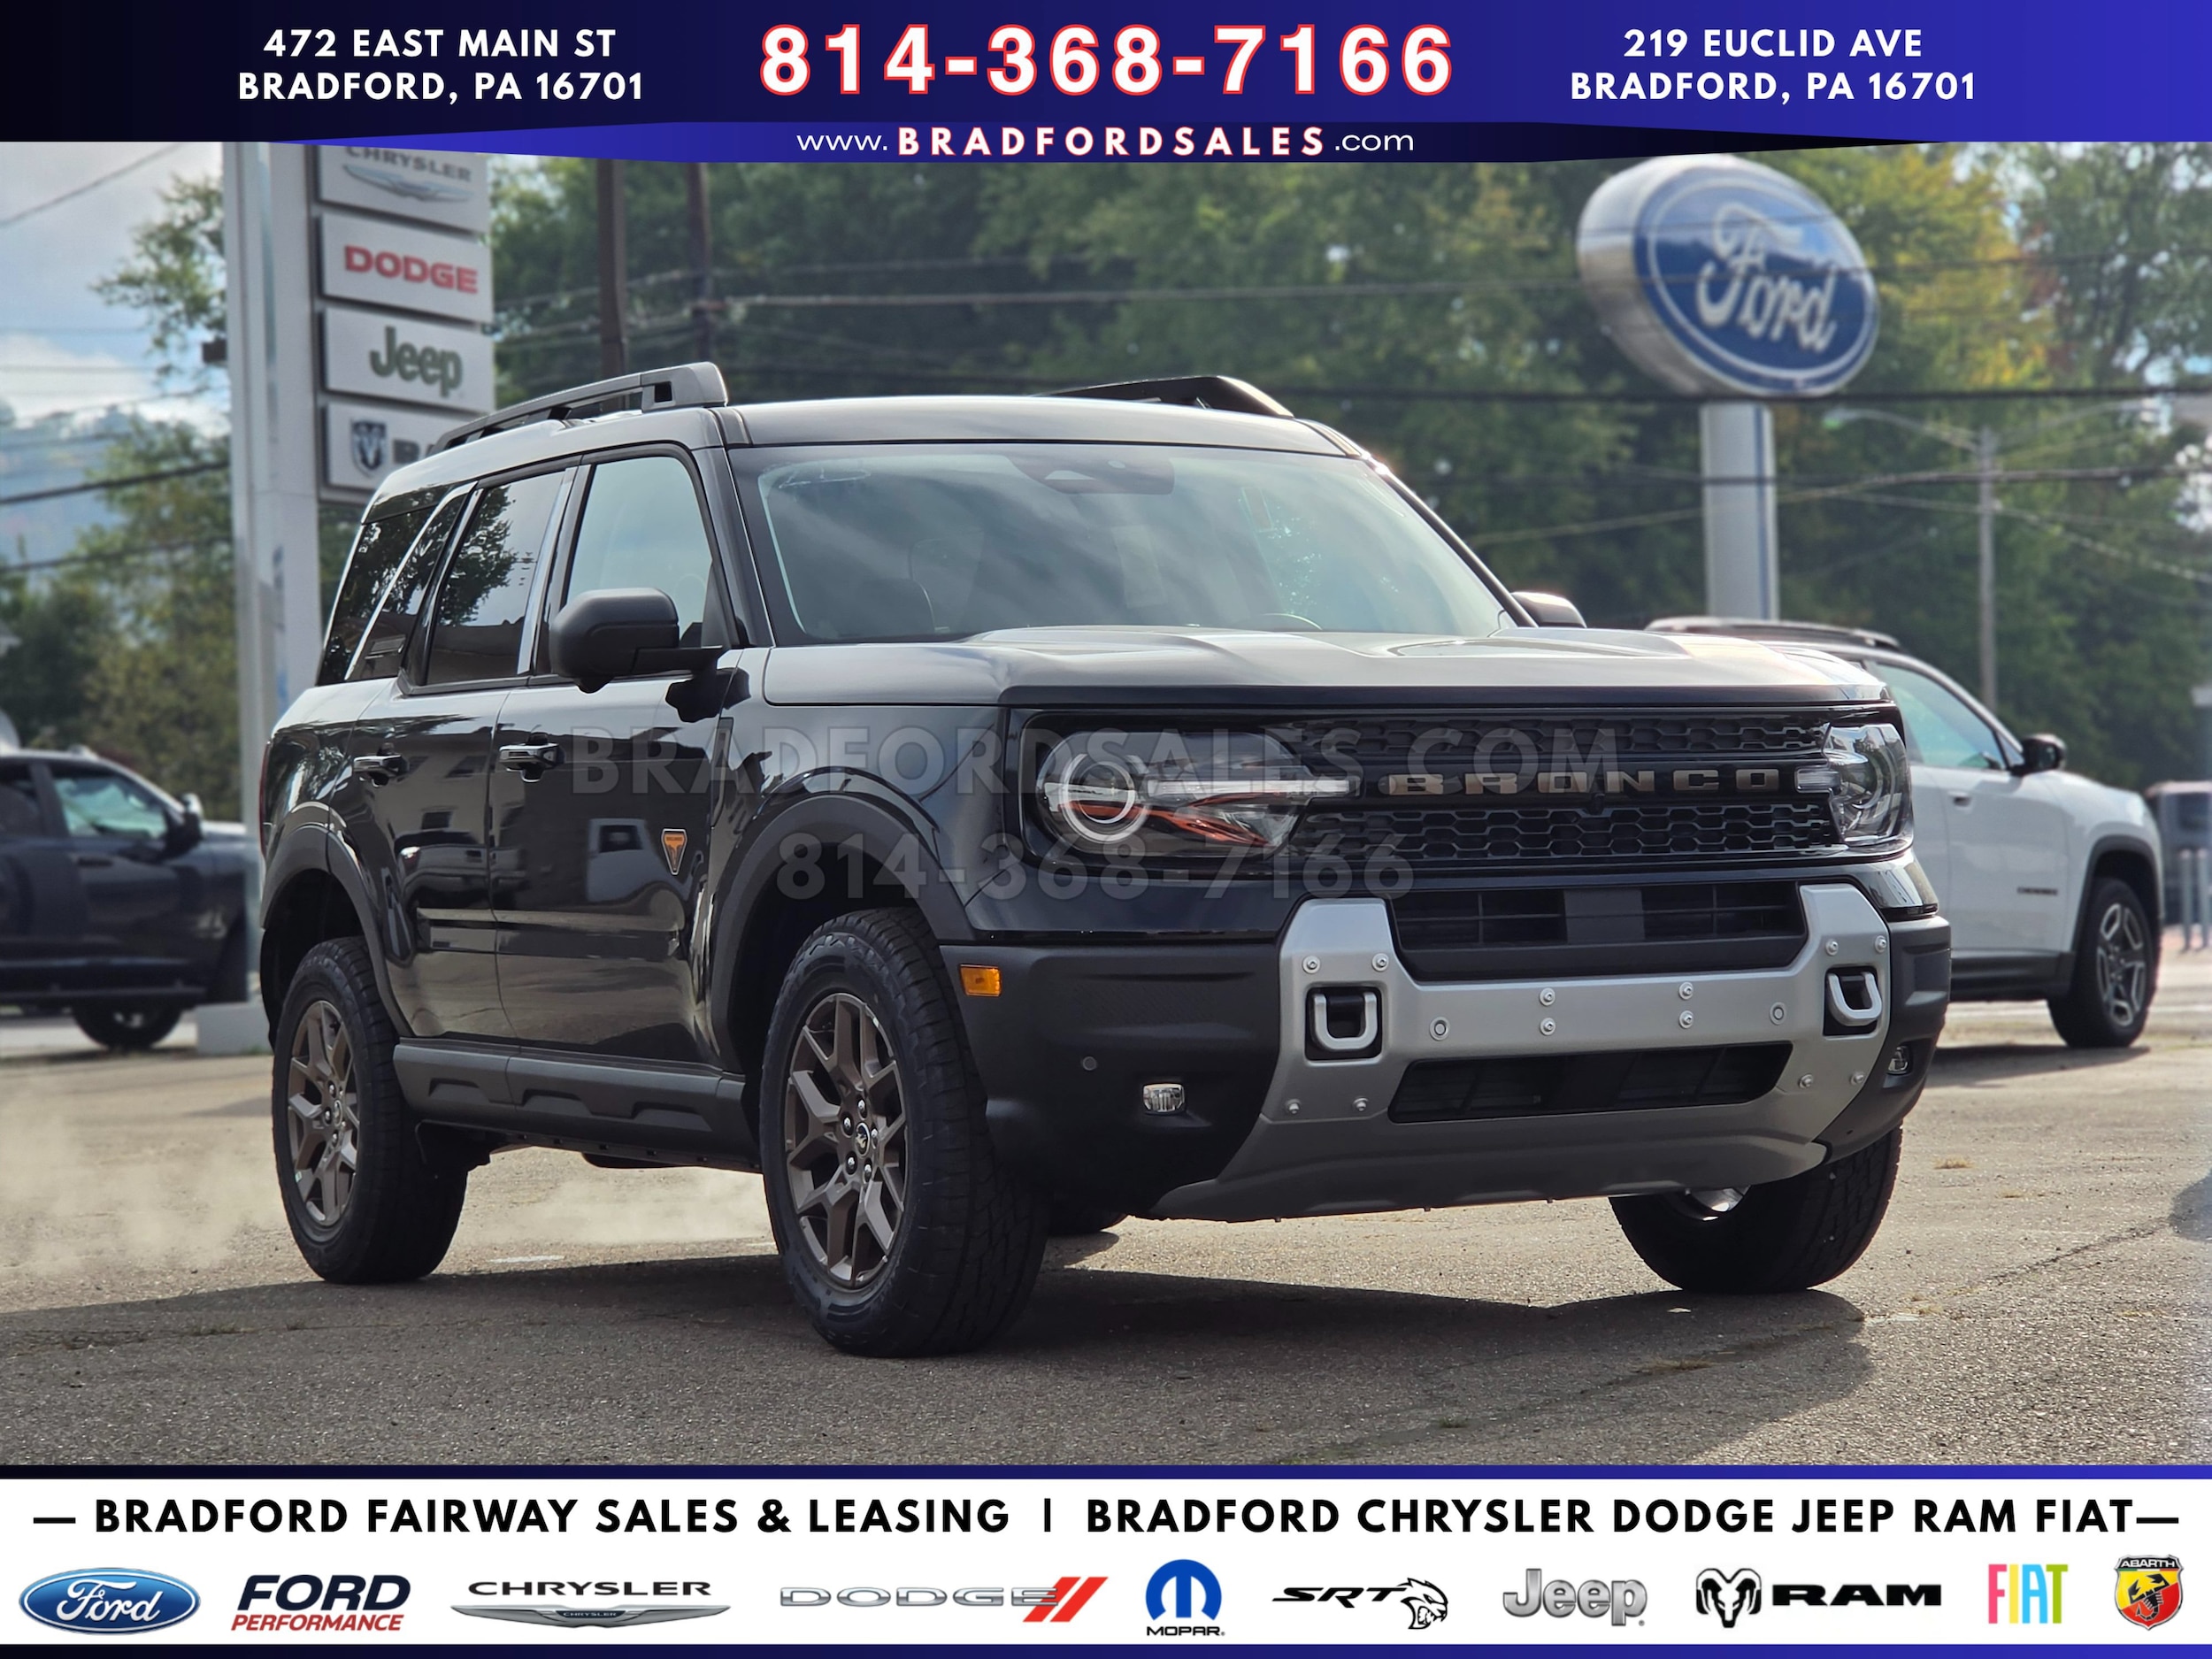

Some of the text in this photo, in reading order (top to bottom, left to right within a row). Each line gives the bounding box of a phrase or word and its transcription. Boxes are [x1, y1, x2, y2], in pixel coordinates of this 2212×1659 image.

[345, 146, 472, 183] CHRYSLER
[343, 244, 479, 295] DODGE
[1696, 200, 1838, 353] Ford
[369, 325, 464, 398] Jeep
[1388, 767, 1780, 795] BRONCO
